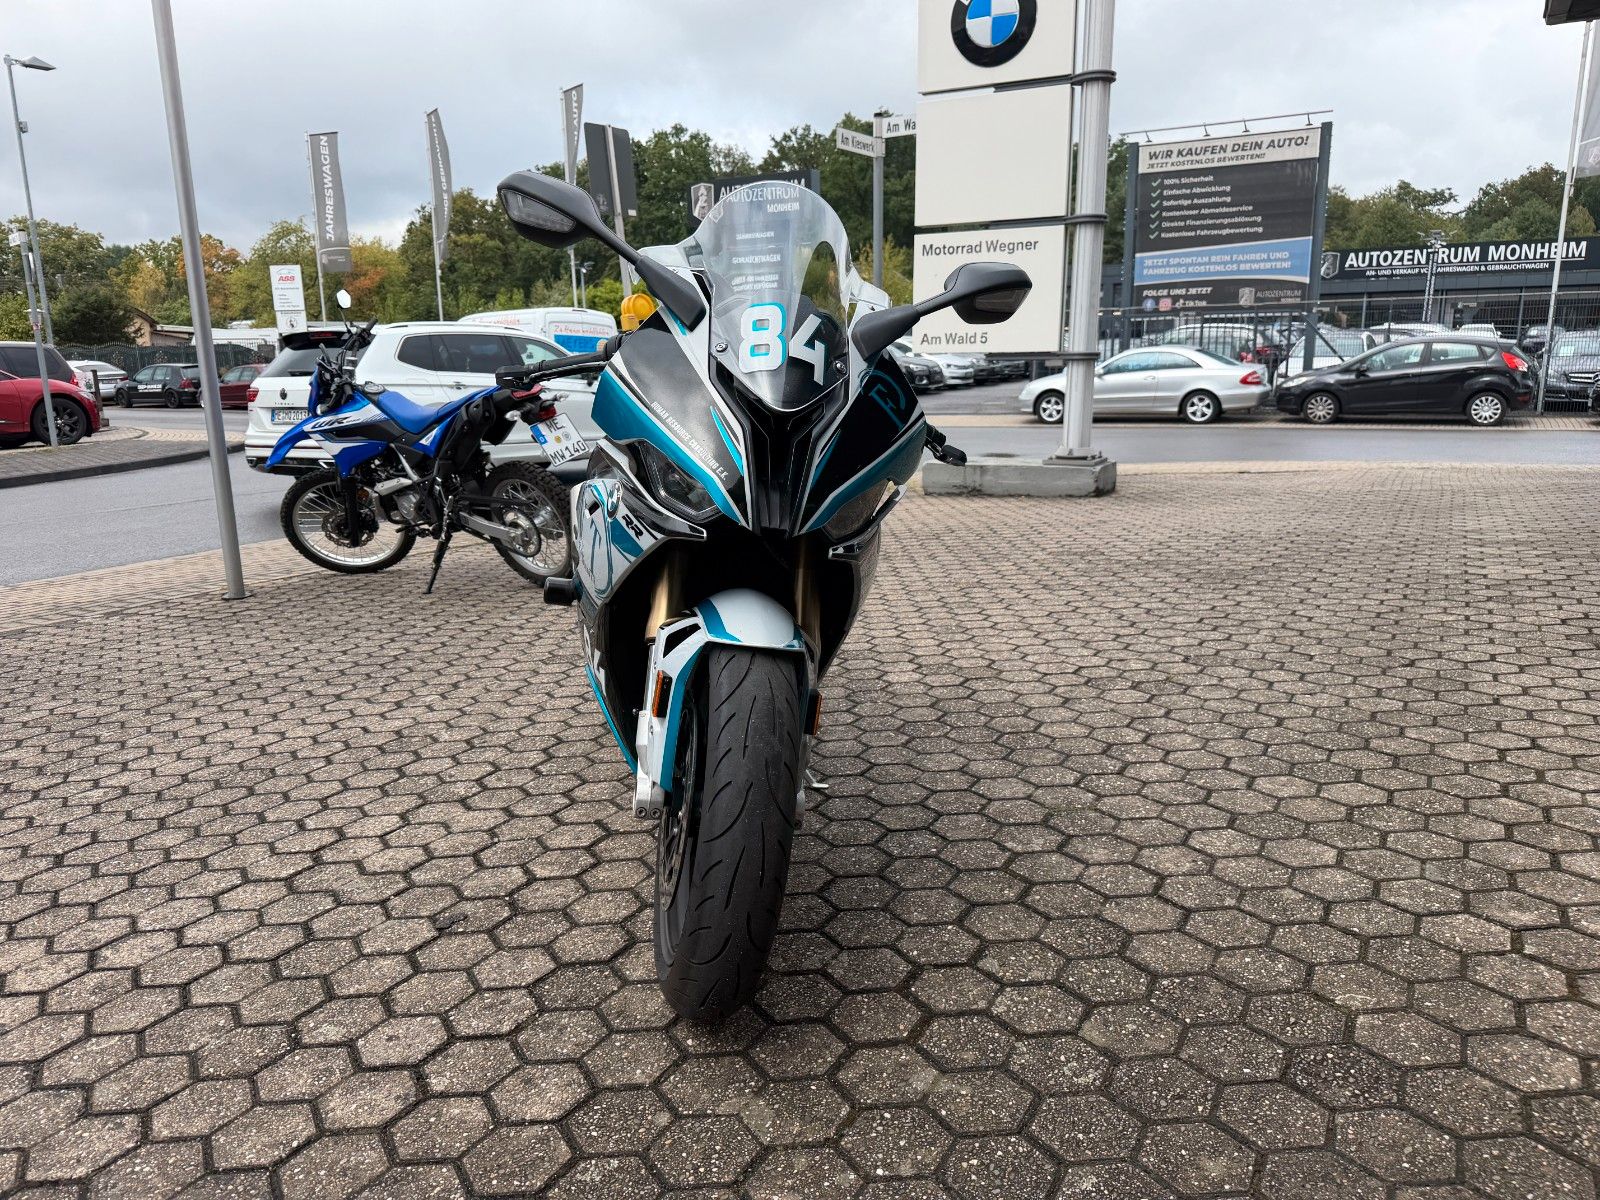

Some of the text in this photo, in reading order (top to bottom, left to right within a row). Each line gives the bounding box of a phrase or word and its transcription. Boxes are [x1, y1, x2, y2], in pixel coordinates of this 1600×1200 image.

[886, 121, 900, 134] Am
[840, 132, 875, 153] Am Kieswerk
[1148, 135, 1309, 161] WIR KAUFEN DEIN AUTO!
[1146, 161, 1169, 170] JETZT
[1170, 157, 1215, 167] KOSTENLOS
[1181, 175, 1214, 184] Sicherheit
[320, 135, 335, 242] JAHRESWAGEN
[1163, 185, 1231, 196] Einfache Abwicklung
[1192, 196, 1231, 204] Auszahlung
[767, 202, 799, 213] MONHEIM
[921, 239, 1039, 257] Motorrad Wegner
[1344, 241, 1587, 268] AUTOZENTRUM MONHEIM
[1143, 251, 1289, 266] JETZT SPONTAN REIN FAHREN UND
[1143, 261, 1291, 275] FAHRZEUG KOSTENLOS BEWERTEN!
[1392, 267, 1419, 275] VERKAUF
[1436, 265, 1480, 273] AHRESWAGEN
[1487, 262, 1549, 271] GEBRAUCHTWAGEN
[1142, 286, 1213, 296] FOLGE UNS JETZT
[738, 302, 826, 386] 84
[920, 331, 988, 345] Am Wald 5
[650, 401, 669, 420] HUMAN
[545, 417, 566, 434] ME
